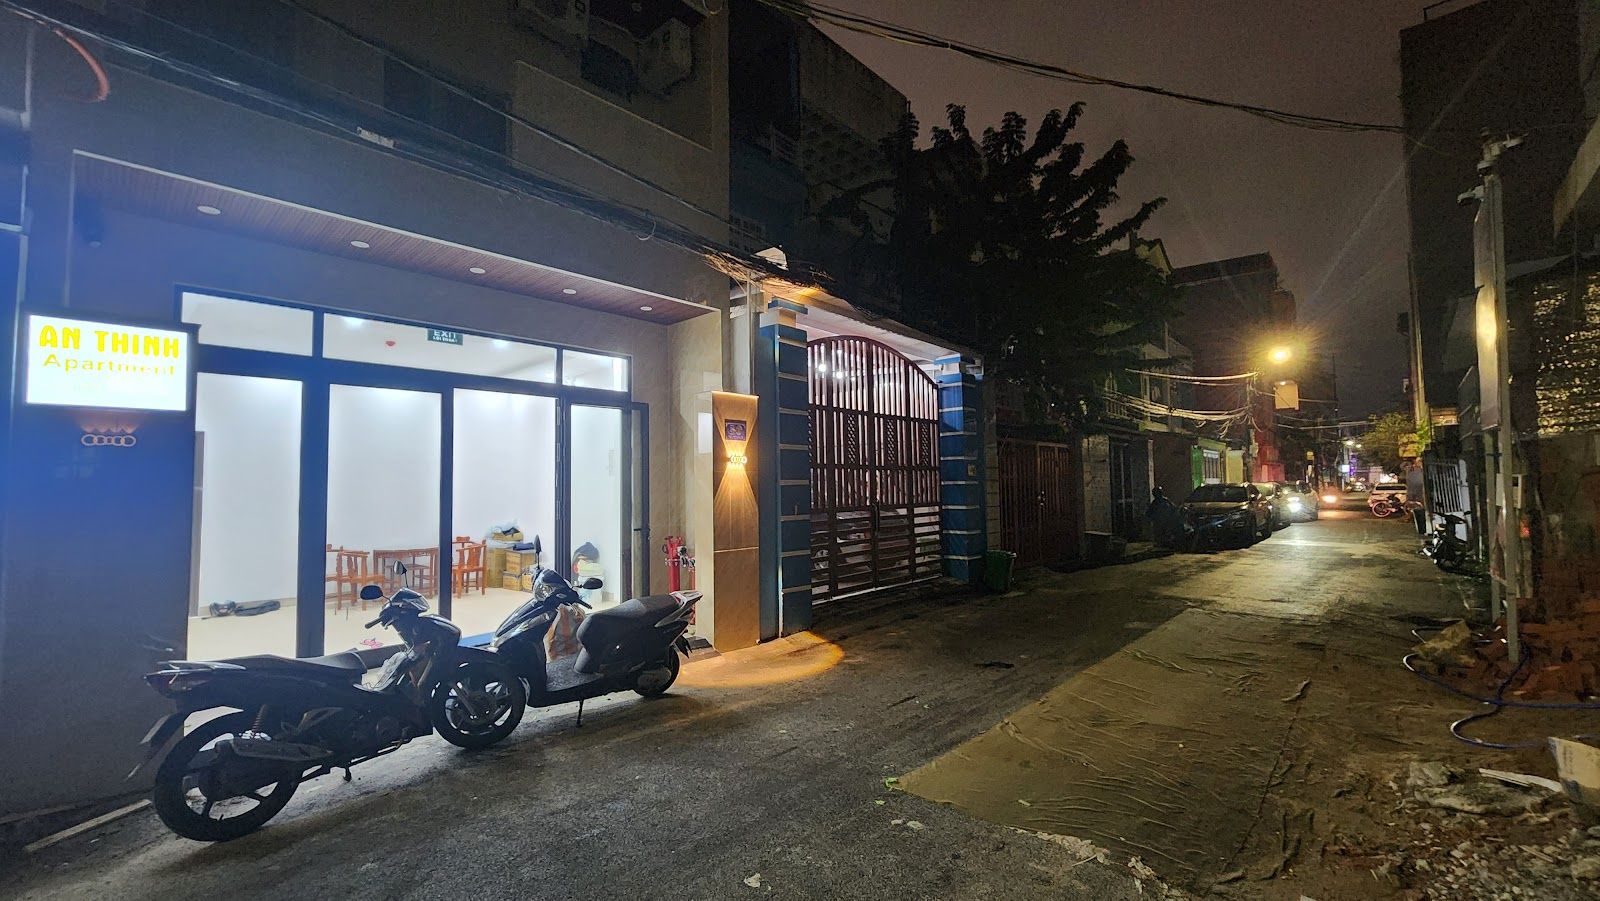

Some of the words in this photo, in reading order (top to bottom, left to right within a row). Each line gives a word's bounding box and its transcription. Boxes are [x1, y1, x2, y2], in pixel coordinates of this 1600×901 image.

[39, 325, 81, 350] AN
[94, 330, 179, 359] THINH
[433, 329, 456, 338] EXIT
[43, 353, 176, 375] Apartment
